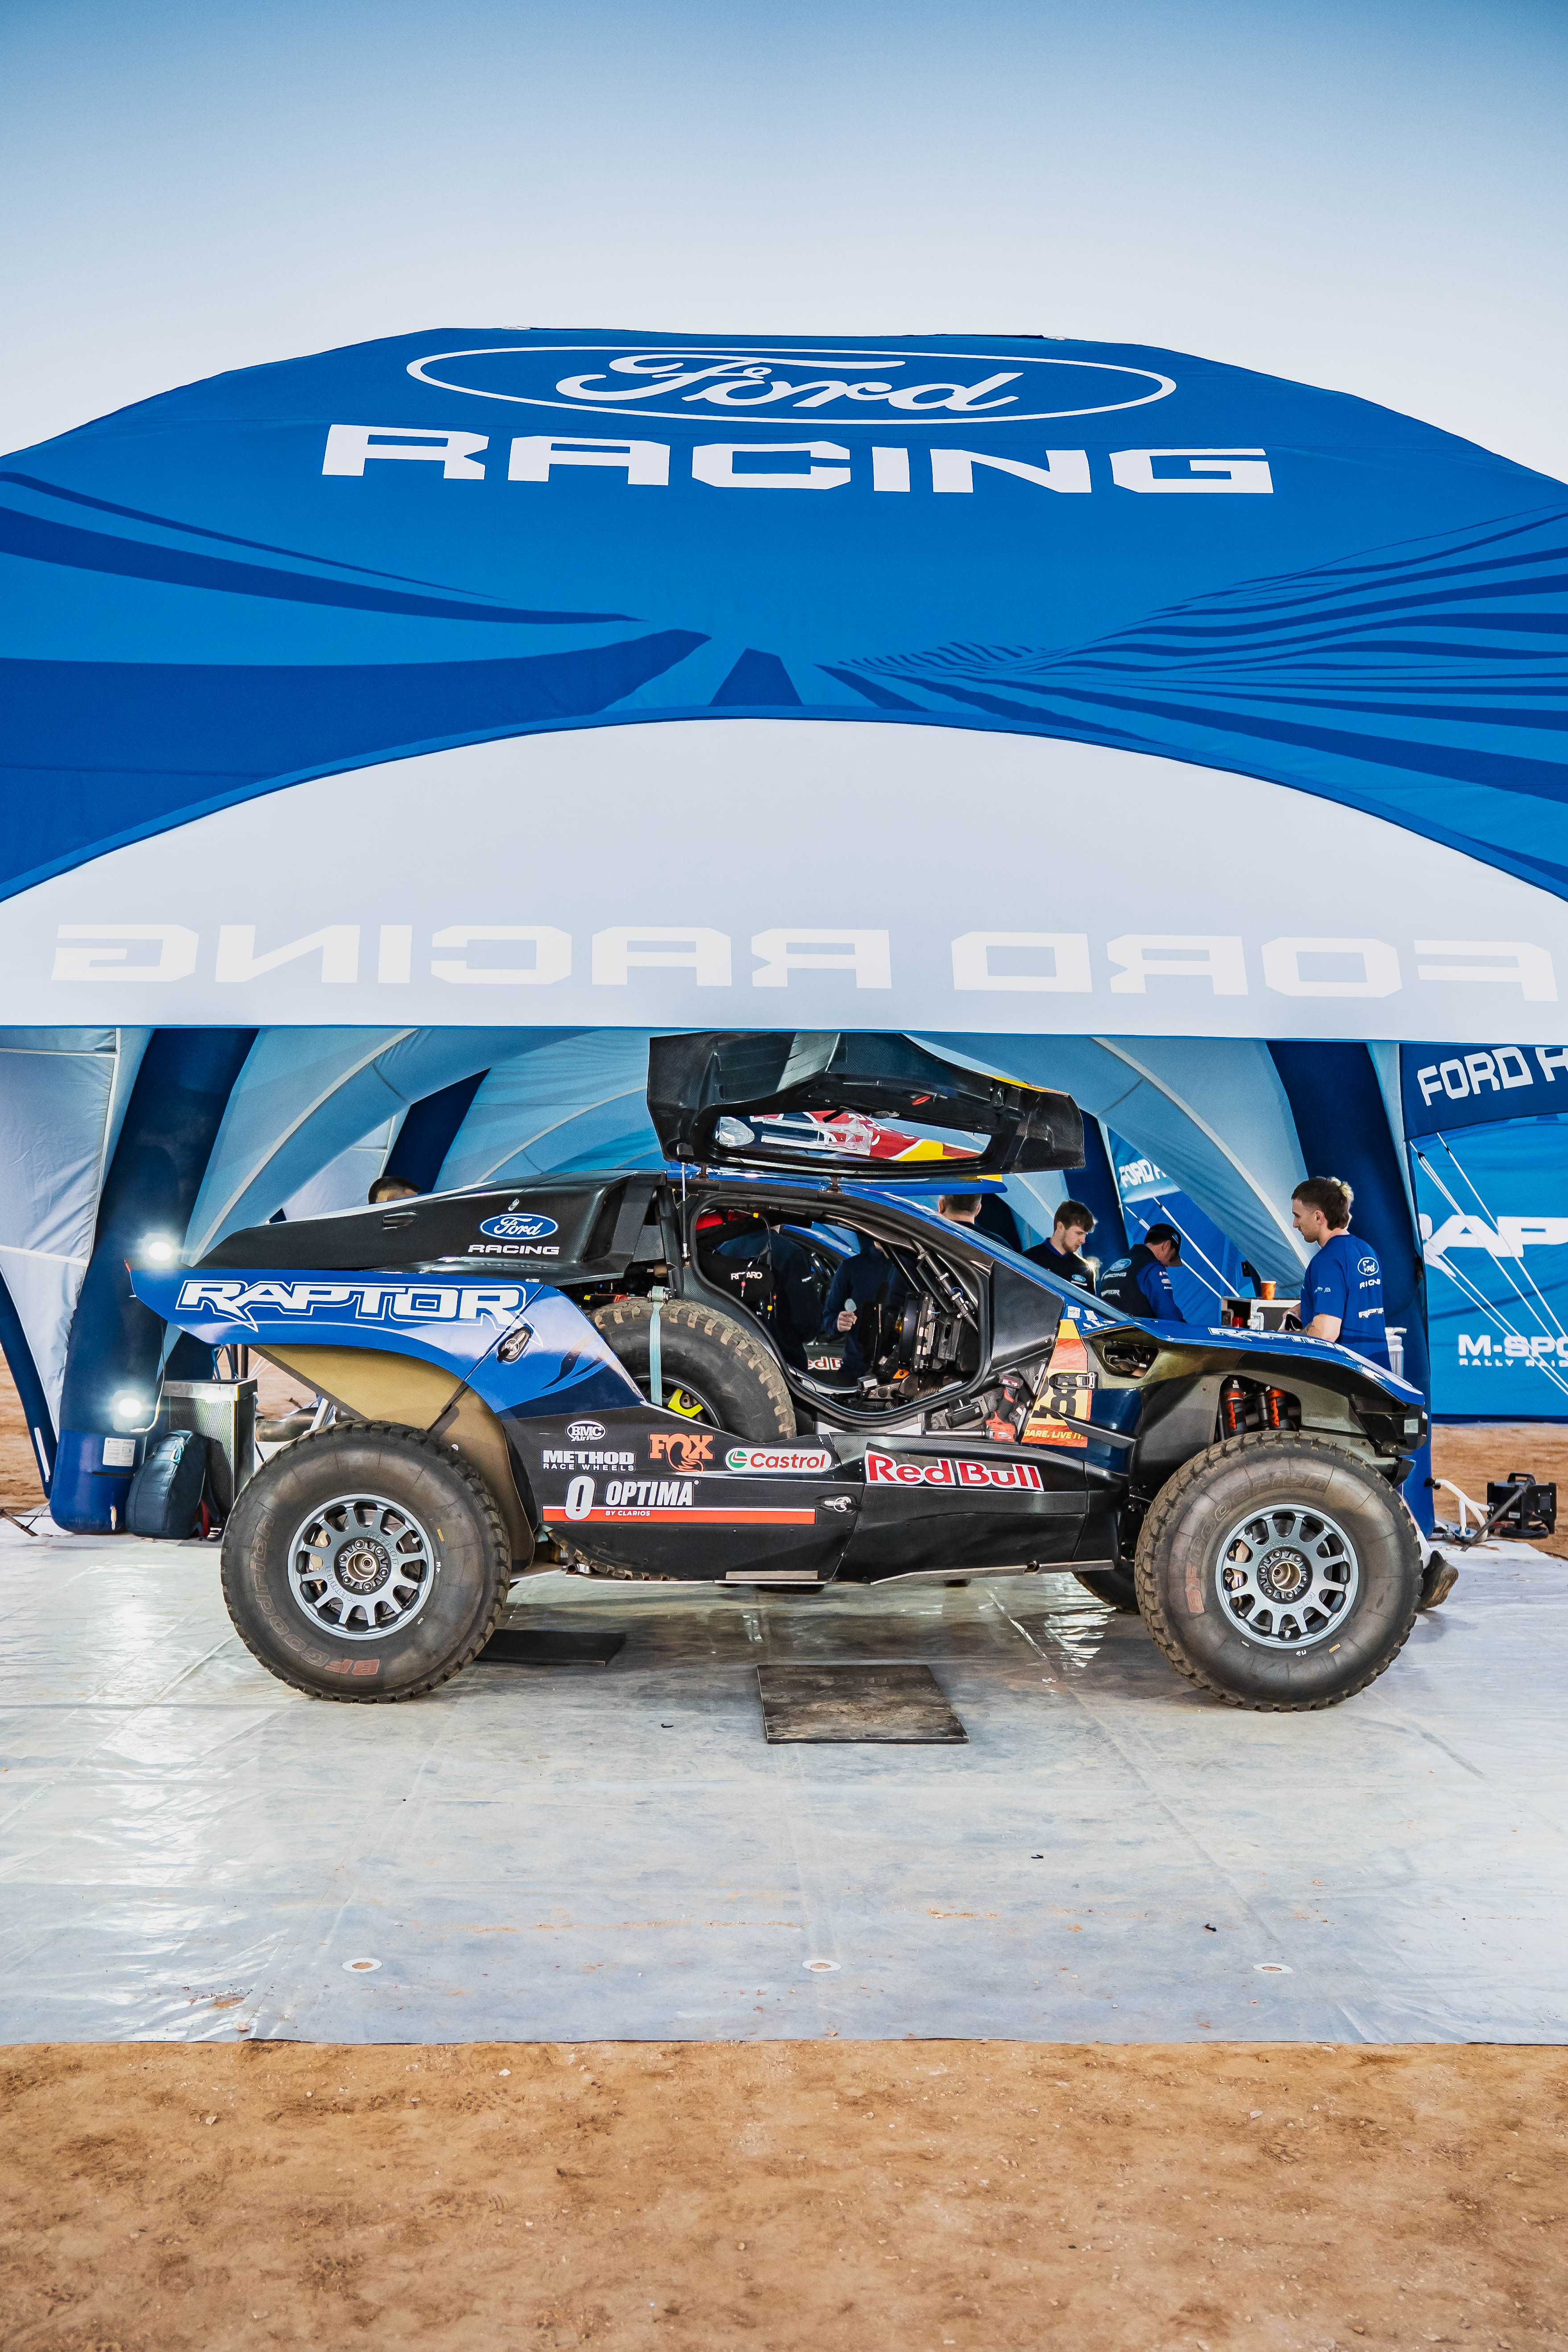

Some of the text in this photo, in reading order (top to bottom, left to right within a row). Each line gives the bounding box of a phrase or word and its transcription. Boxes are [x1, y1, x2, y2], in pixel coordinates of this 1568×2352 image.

[556, 354, 1024, 412] Ford
[321, 424, 1274, 494] RACING
[1417, 1046, 1533, 1106] FORD
[1119, 1159, 1155, 1188] FORD
[494, 1216, 543, 1235] Ford
[468, 1244, 560, 1255] RACING
[731, 1271, 763, 1280] REARO
[177, 1281, 540, 1341] RAPTOR
[1459, 1358, 1514, 1366] RALLY
[572, 1426, 602, 1437] BMC
[1051, 1431, 1072, 1439] LIVE
[543, 1450, 635, 1465] METHOD
[650, 1433, 713, 1465] FOX
[750, 1452, 826, 1469] Castrol
[867, 1454, 1043, 1490] Red Bull
